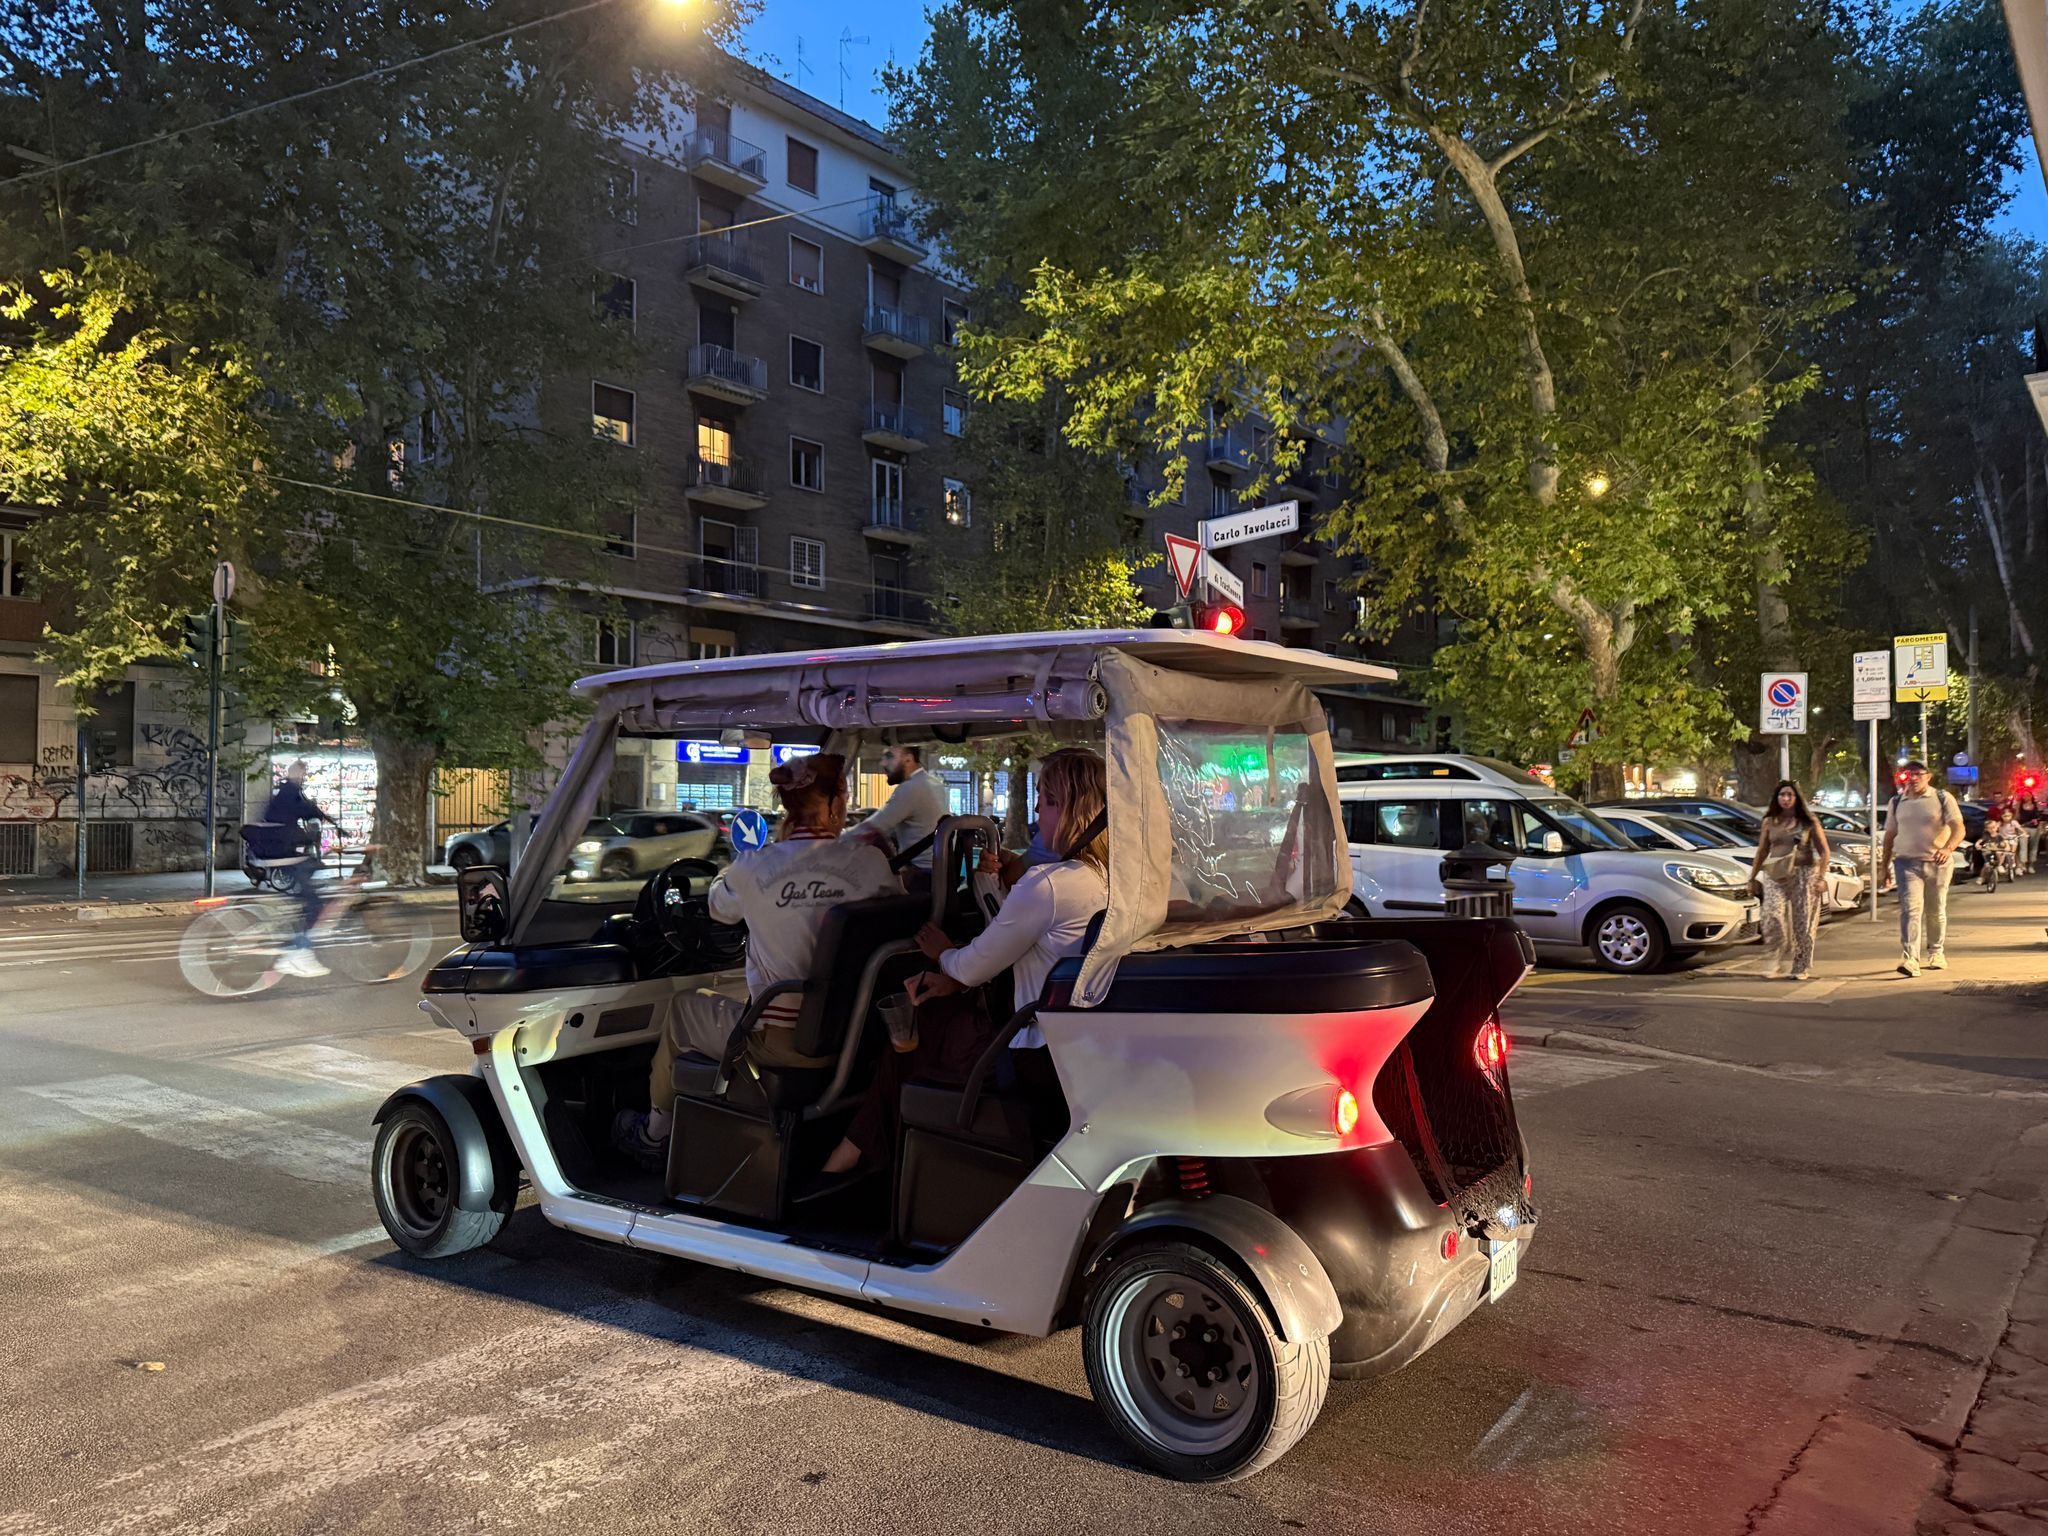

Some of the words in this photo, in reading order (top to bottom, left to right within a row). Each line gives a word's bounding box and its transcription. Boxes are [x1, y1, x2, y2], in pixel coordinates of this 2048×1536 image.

[1213, 529, 1240, 542] Carlo
[1244, 515, 1290, 535] Tavolacci
[1896, 635, 1944, 643] PARCOMETRO
[775, 881, 808, 908] Gas
[807, 880, 845, 899] Team
[1493, 1246, 1516, 1292] 97020
